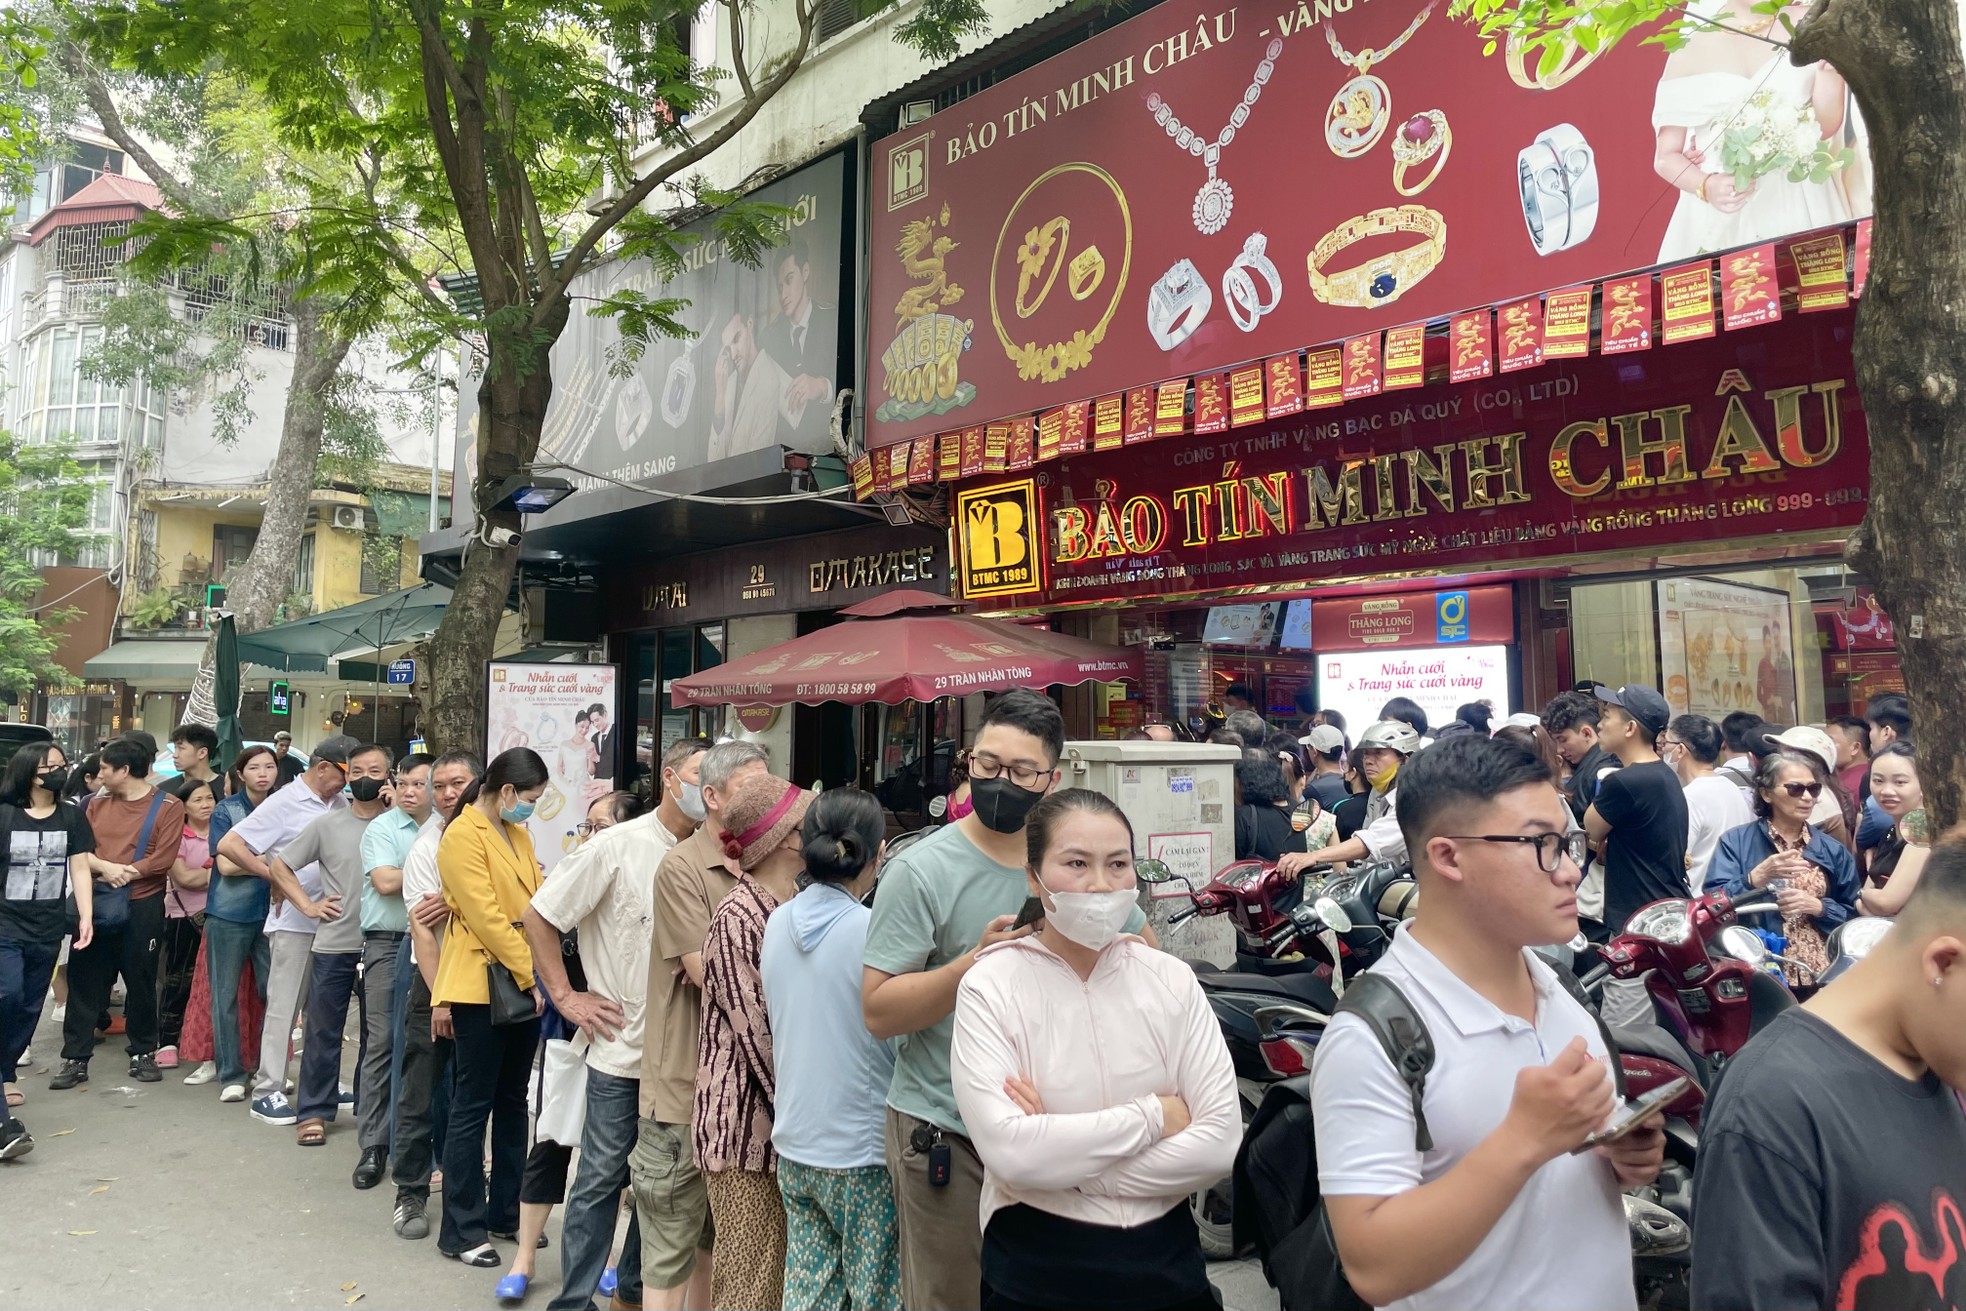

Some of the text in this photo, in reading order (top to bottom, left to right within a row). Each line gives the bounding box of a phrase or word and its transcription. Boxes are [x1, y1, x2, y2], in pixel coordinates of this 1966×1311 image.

[946, 122, 997, 165] BẢO
[1003, 96, 1048, 139] TÍN
[1055, 55, 1136, 117] MINH
[1143, 7, 1237, 75] CHÂU
[682, 239, 717, 275] SỨC
[1667, 285, 1687, 296] VÀNG
[1668, 289, 1709, 303] THĂNG LONG
[1549, 310, 1586, 320] THĂNG LONG
[1550, 305, 1568, 313] VÀNG
[1727, 308, 1765, 321] TIÊU CHUẨN
[1727, 317, 1752, 327] QUỐC
[1604, 343, 1626, 351] QUỐC
[1618, 336, 1638, 344] CHUẨN
[1502, 361, 1522, 370] QUỐC
[1174, 443, 1215, 467] CÔNG
[1219, 443, 1238, 457] TY
[1244, 431, 1287, 454] TNHH
[1292, 421, 1340, 446] VÀNG
[1345, 414, 1382, 438] BẠC
[1390, 405, 1416, 428] ĐÁ
[1422, 397, 1462, 425] QUÝ
[1530, 374, 1580, 402] LTD)
[612, 462, 640, 484] THÊM
[644, 455, 676, 478] SANG
[1053, 368, 1846, 564] BẢO TÍN MINH CHÂU
[1077, 573, 1109, 587] DOANH
[1137, 565, 1165, 582] RỒNG
[1166, 562, 1201, 579] THĂNG
[1261, 552, 1274, 568] VÀ
[1279, 550, 1308, 567] VÀNG
[1311, 548, 1351, 564] TRANG
[1353, 542, 1376, 559] SỨC
[1381, 539, 1399, 556] MỸ
[1442, 528, 1477, 549] CHẤT
[1482, 526, 1512, 546] LIỆU
[1515, 519, 1556, 542] BẰNG
[1560, 515, 1603, 535] VÀNG
[1606, 508, 1653, 531] RỒNG
[1656, 503, 1718, 525] THĂNG
[750, 564, 766, 584] 29
[810, 545, 935, 593] OMAKASE
[973, 567, 1028, 586] BTMC 1989
[1363, 600, 1398, 610] VÀNG RỒNG
[1350, 615, 1412, 629] THĂNG LONG
[1078, 659, 1129, 673] www.btmc.vn
[1381, 660, 1445, 676] Nhẫn cưới
[395, 673, 407, 682] 17
[528, 671, 578, 683] Nhẫn cưới
[935, 665, 1032, 690] 29 TRẦN NHÂN TÔNG
[1348, 674, 1483, 691] & Trang sức cưới vàng
[499, 682, 604, 695] & Trang sức cưới vàng
[688, 687, 699, 699] 29
[723, 682, 747, 697] NHÂN
[749, 682, 773, 695] TÔNG
[796, 683, 876, 696] ĐT: 1800 58 58 99
[274, 692, 287, 706] aha
[741, 707, 771, 718] OMAKASE
